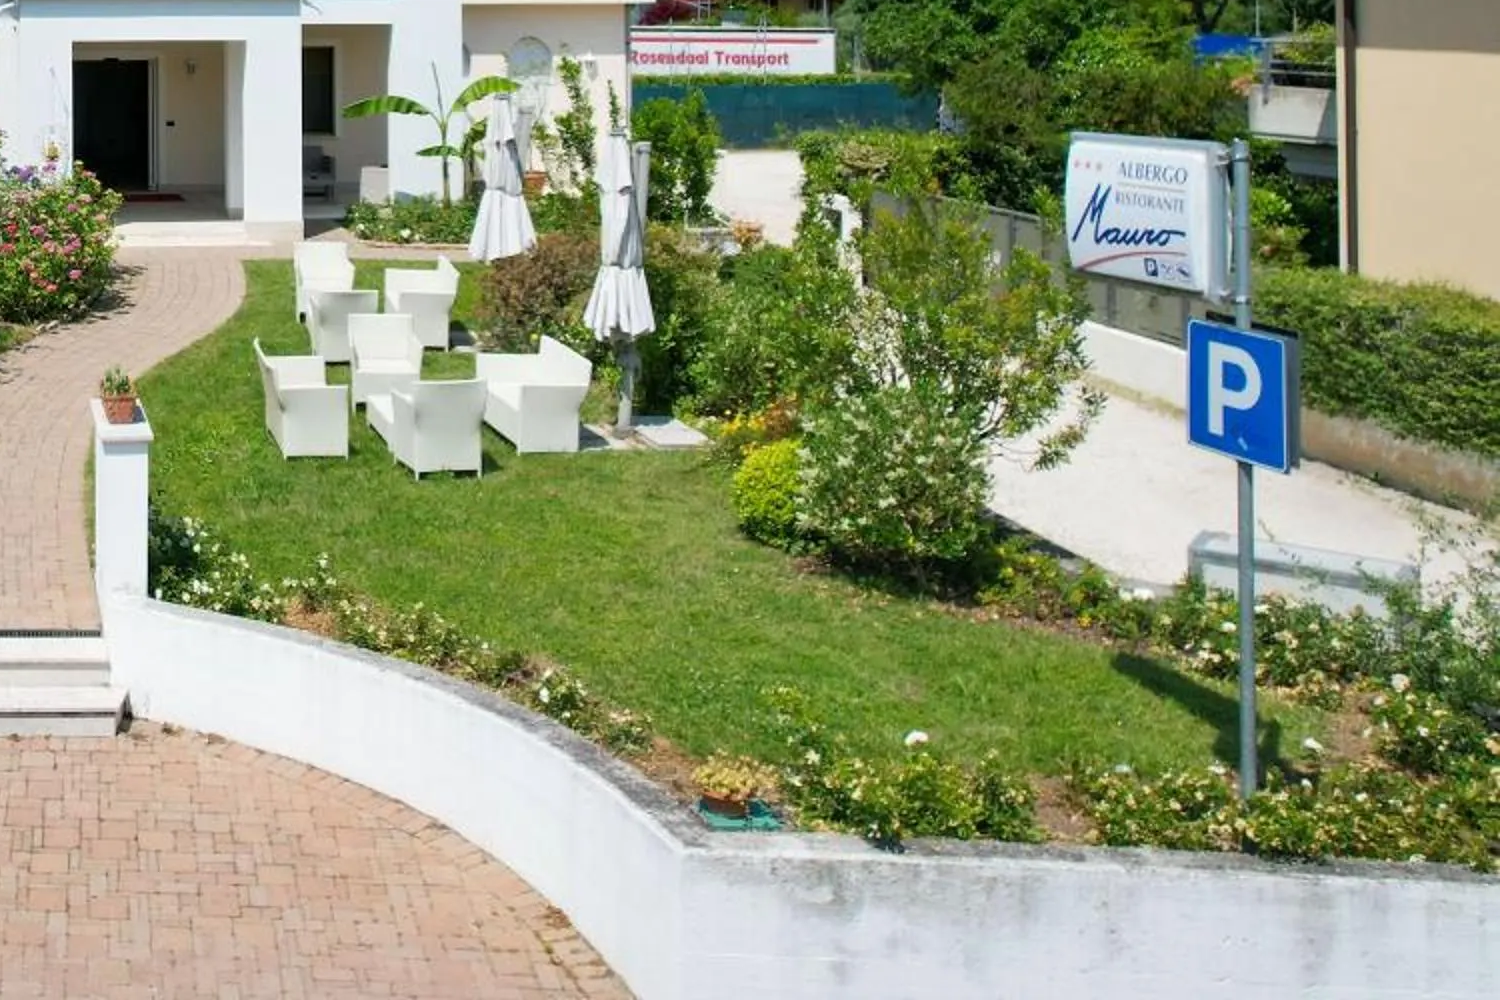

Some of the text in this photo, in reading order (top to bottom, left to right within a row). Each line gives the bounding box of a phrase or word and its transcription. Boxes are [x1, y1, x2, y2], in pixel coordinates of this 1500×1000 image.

[715, 50, 789, 68] Transport
[1118, 160, 1189, 185] ALBERGO
[1115, 190, 1186, 214] RISTORANTE
[1072, 183, 1187, 247] Mauro
[1208, 341, 1263, 437] P
